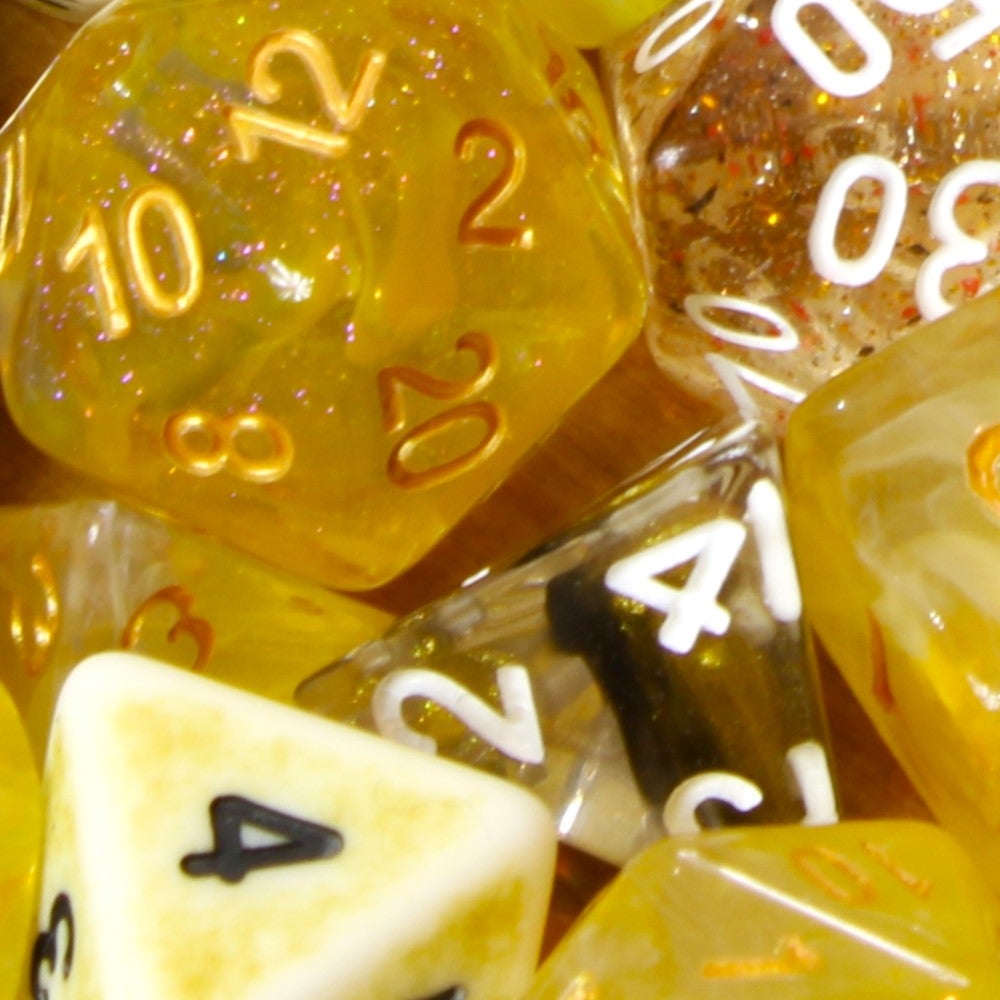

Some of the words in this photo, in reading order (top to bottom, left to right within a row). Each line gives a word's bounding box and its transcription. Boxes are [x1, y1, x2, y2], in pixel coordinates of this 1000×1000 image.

[222, 28, 387, 160] 12
[454, 117, 535, 252] 2
[60, 184, 204, 341] 10
[162, 409, 295, 484] 8
[605, 517, 746, 656] 4
[371, 664, 546, 766] 2
[180, 794, 344, 884] 4
